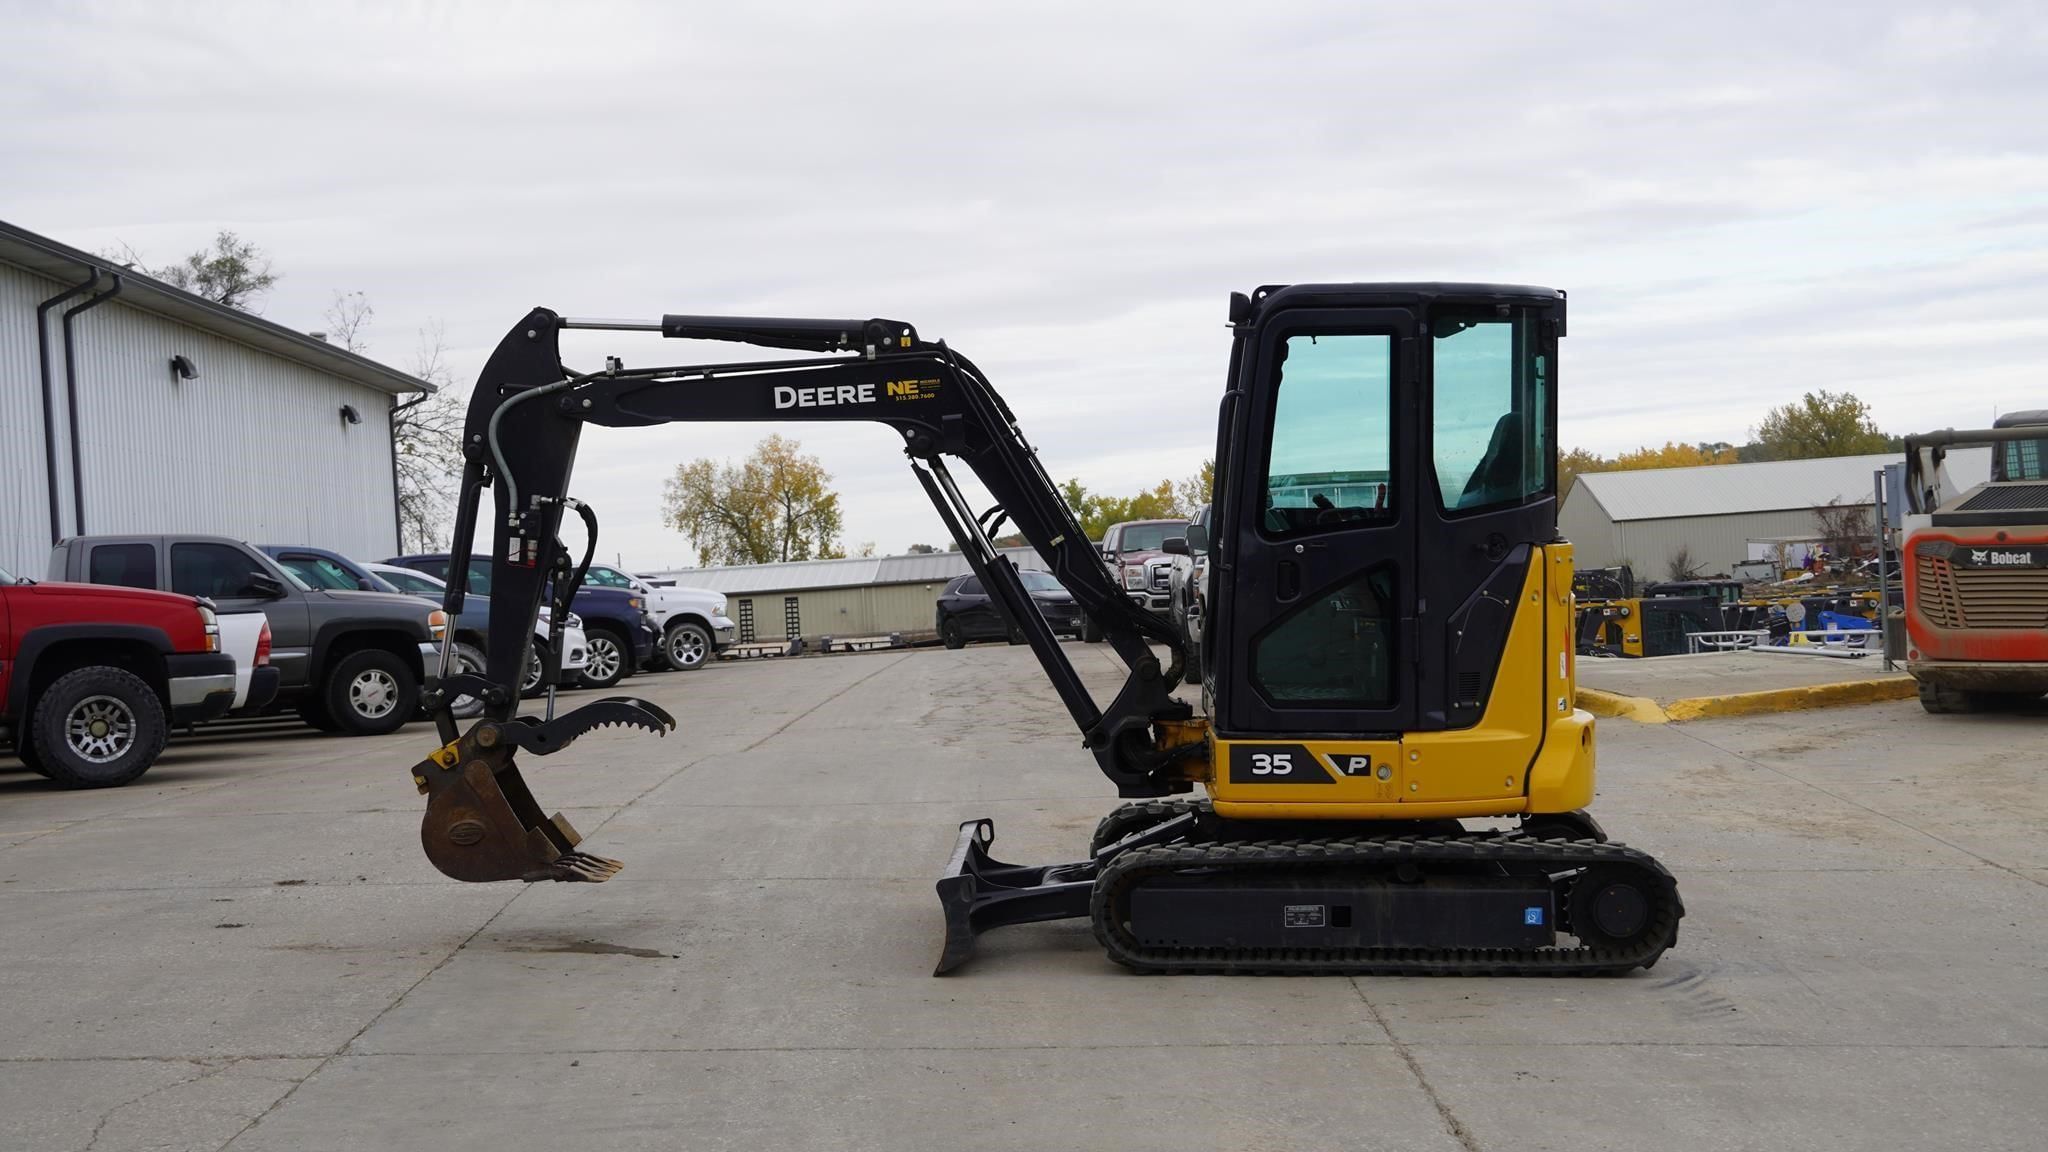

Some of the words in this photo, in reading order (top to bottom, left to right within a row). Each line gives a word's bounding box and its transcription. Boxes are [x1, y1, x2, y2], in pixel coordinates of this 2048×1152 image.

[887, 380, 919, 395] NE
[774, 384, 876, 409] DEERE
[1991, 552, 2031, 564] Bobcat
[1252, 754, 1293, 775] 35
[1348, 757, 1367, 774] P
